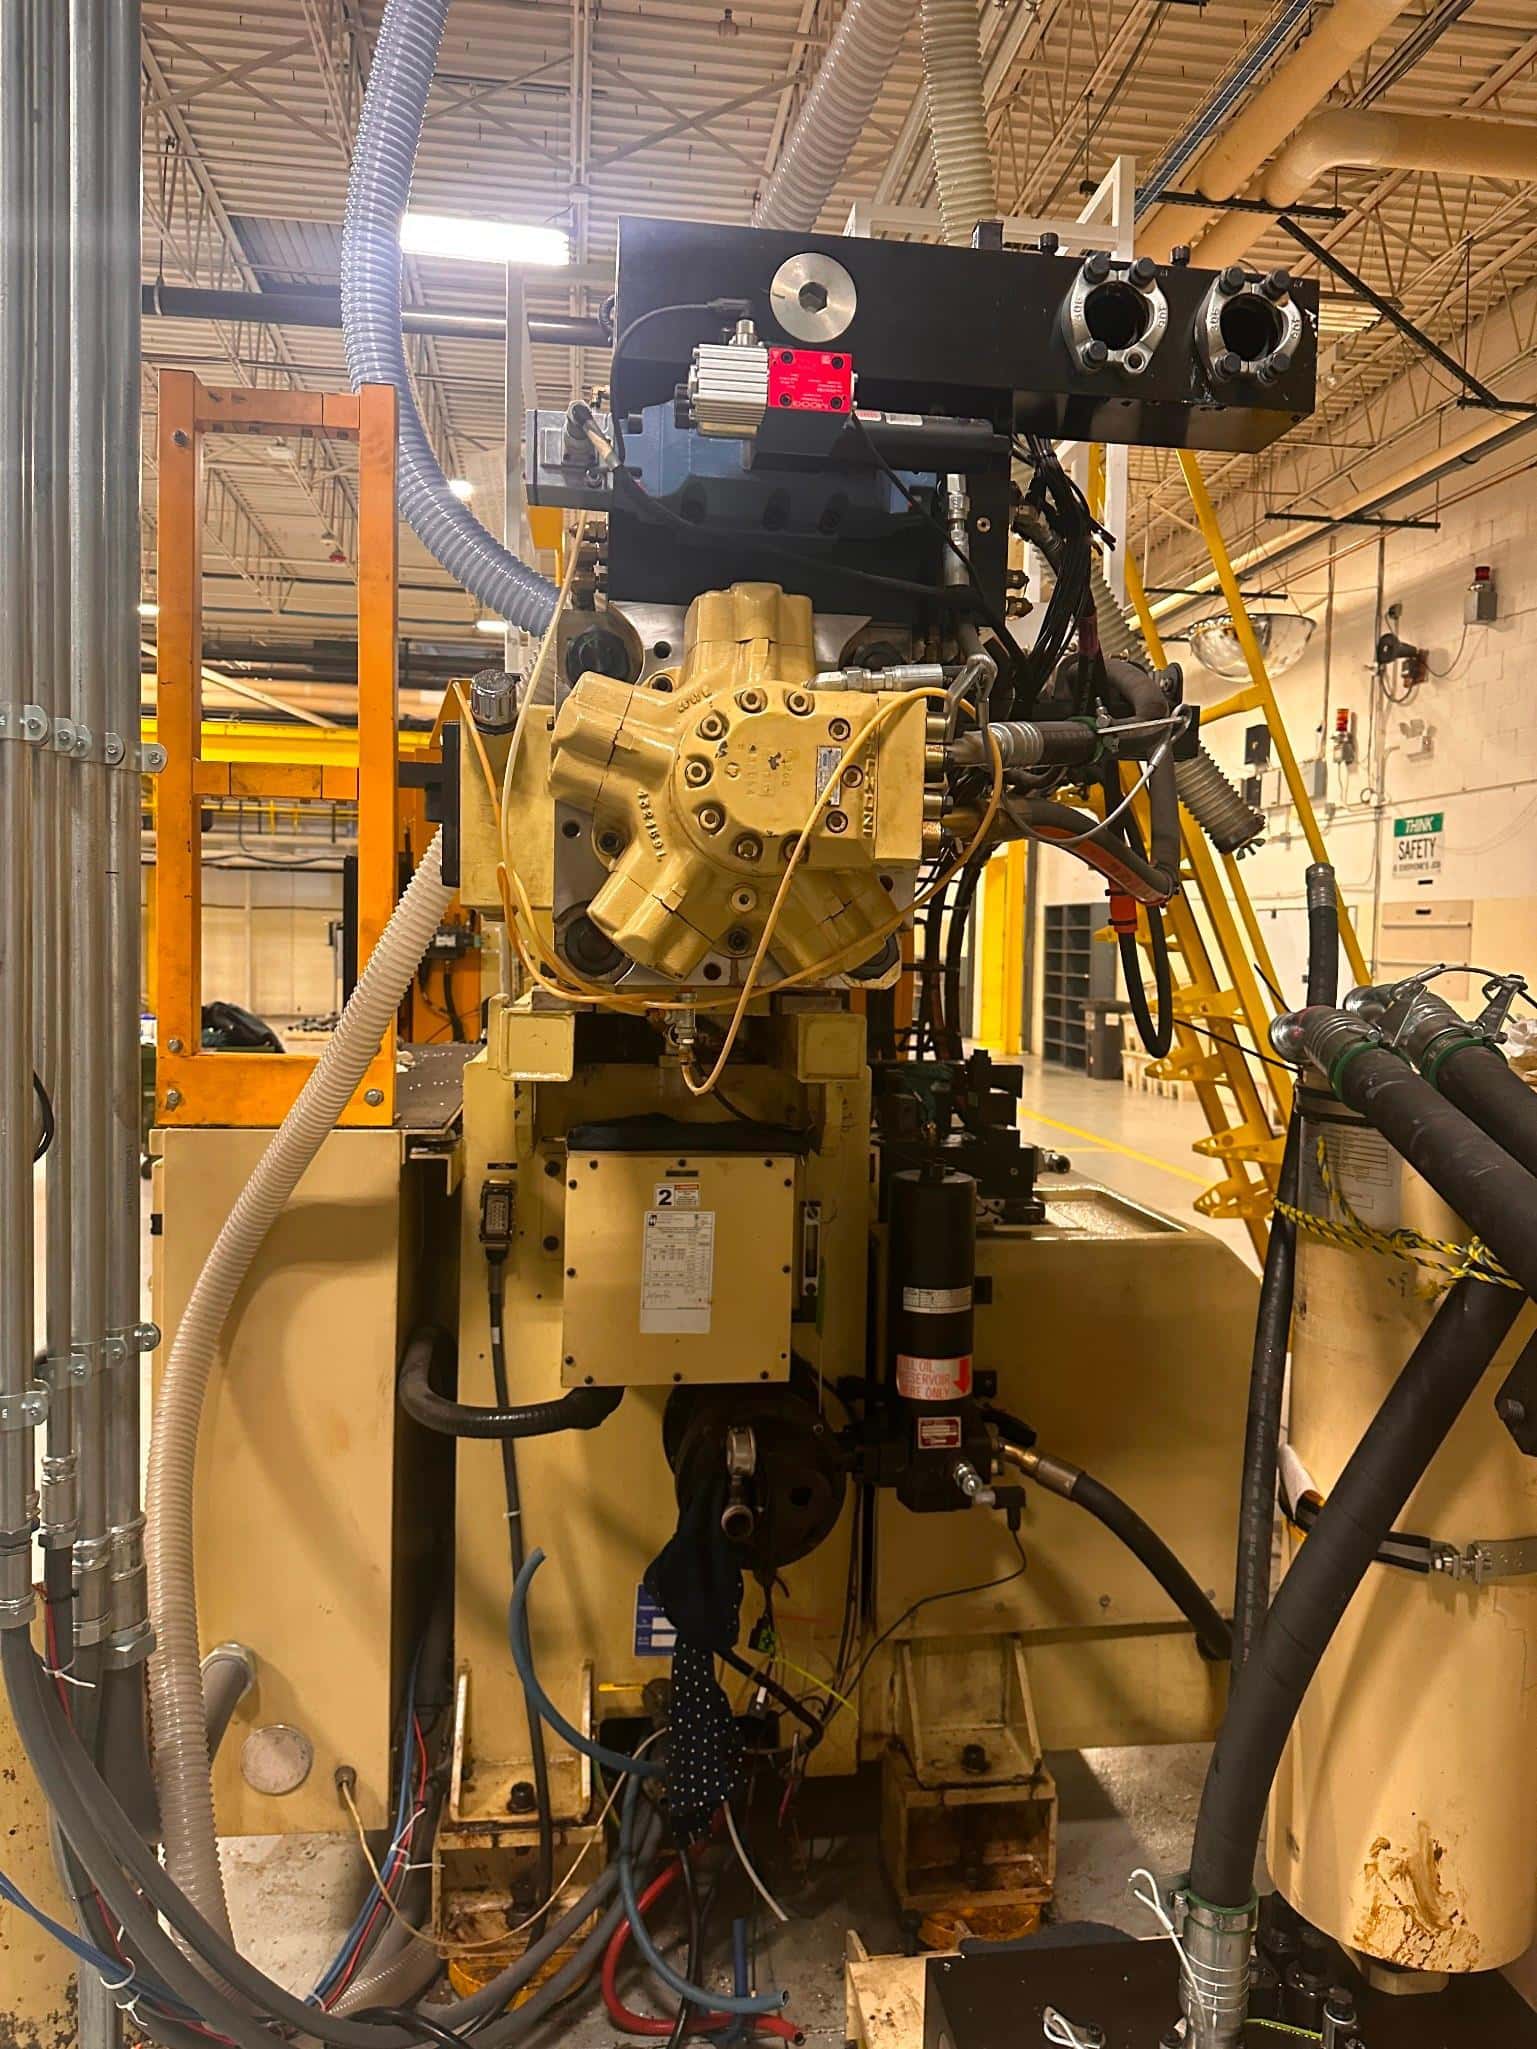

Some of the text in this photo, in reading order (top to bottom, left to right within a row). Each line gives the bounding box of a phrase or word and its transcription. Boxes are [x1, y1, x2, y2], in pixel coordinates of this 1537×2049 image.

[1404, 817, 1434, 833] THINK
[1399, 838, 1437, 860] SAFETY
[658, 1189, 672, 1206] 2
[919, 1360, 934, 1372] OIL
